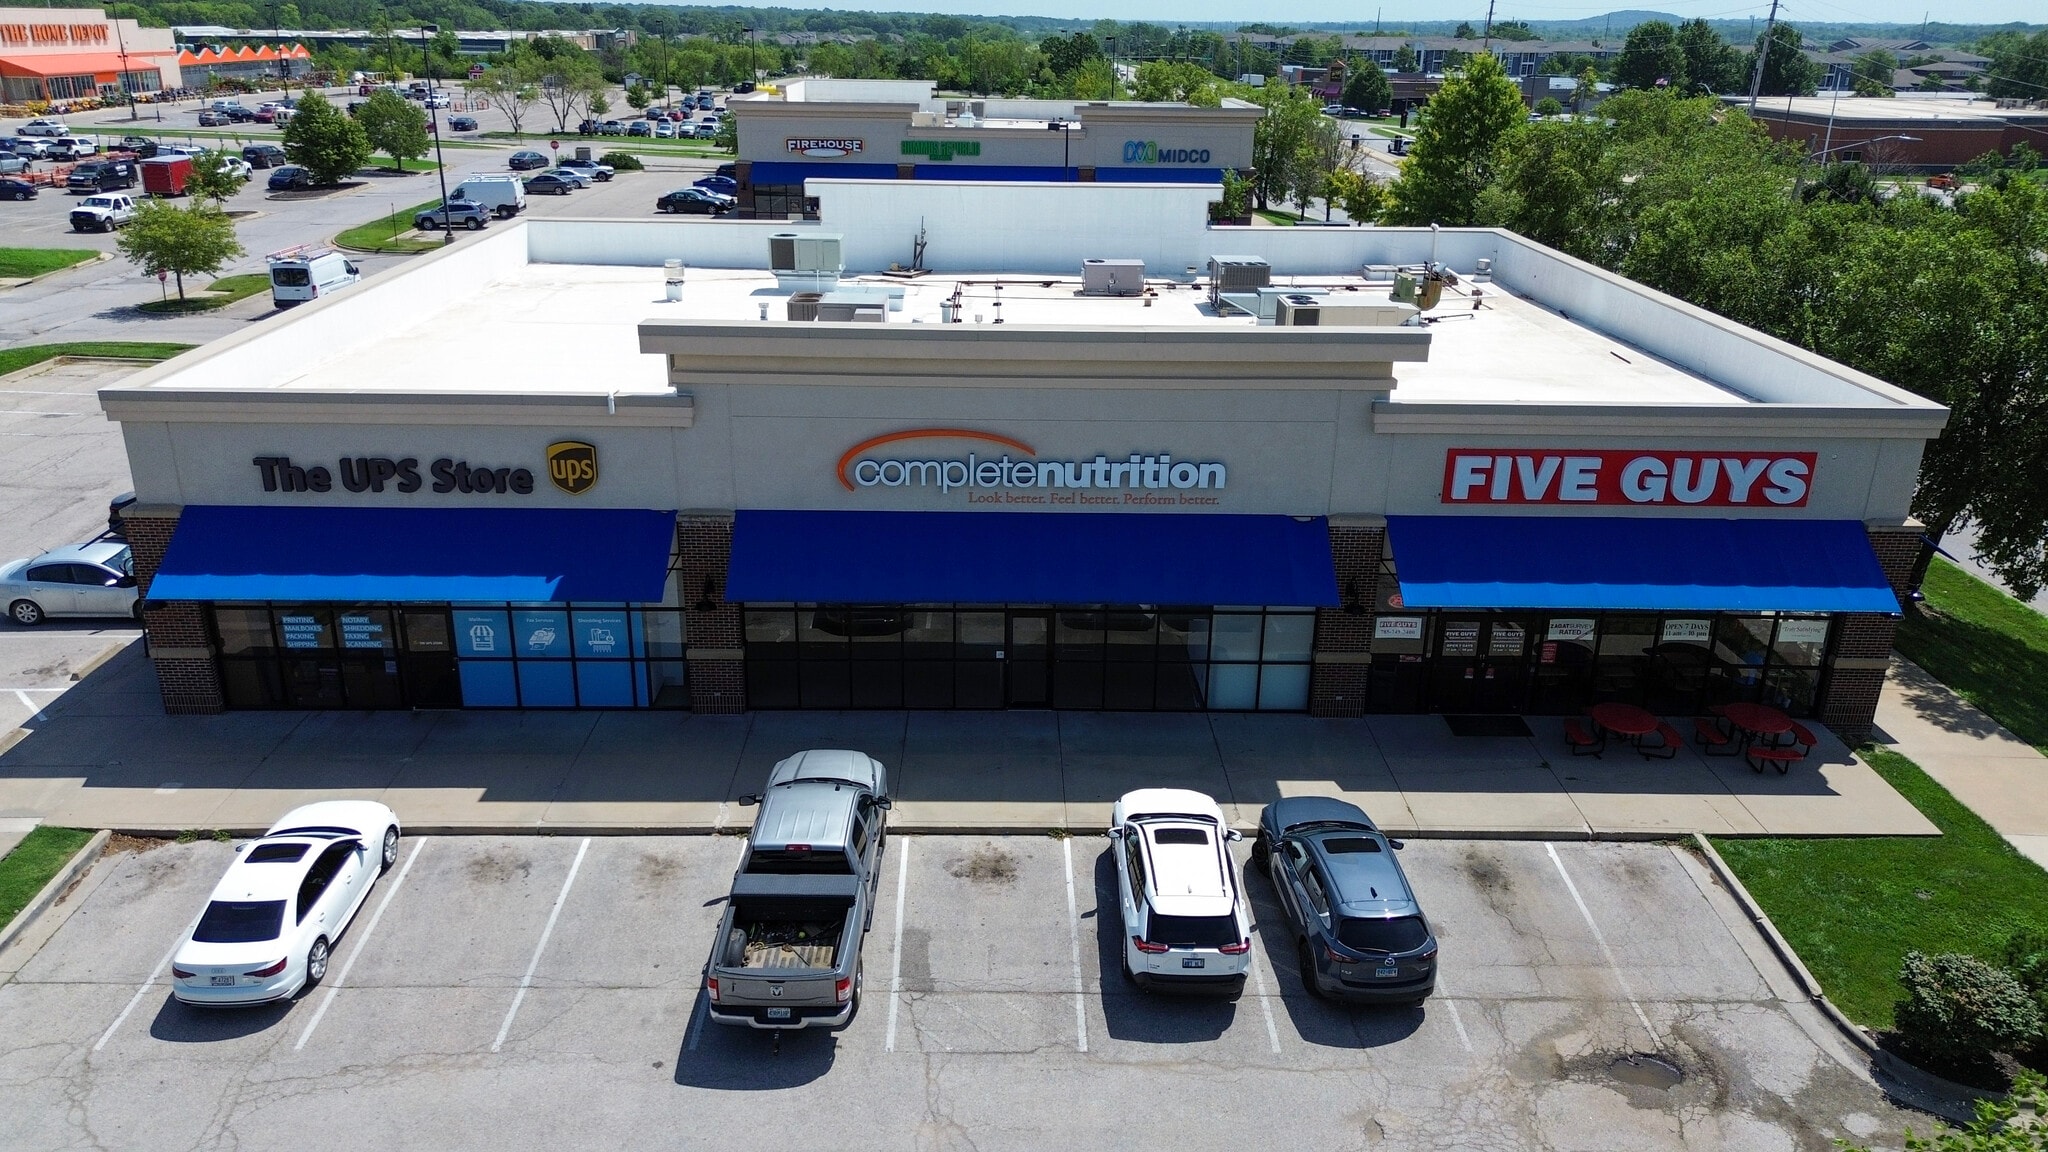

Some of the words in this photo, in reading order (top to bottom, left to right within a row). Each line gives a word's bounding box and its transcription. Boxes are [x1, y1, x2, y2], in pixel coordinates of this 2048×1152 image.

[0, 24, 28, 42] THE
[30, 24, 68, 42] HOME
[69, 24, 108, 41] DEPOT
[787, 139, 862, 153] FIREHOUSE
[1158, 149, 1210, 163] MIDCO
[252, 456, 333, 492] The
[339, 457, 422, 493] UPS
[430, 458, 534, 494] Store
[552, 458, 594, 487] ups
[1450, 455, 1603, 501] FIVE
[1620, 455, 1810, 505] GUYS
[968, 491, 1003, 504] Look
[1005, 491, 1046, 504] better.
[1050, 492, 1075, 504] Feel
[1079, 492, 1120, 505] better.
[1123, 492, 1176, 506] Perform
[1179, 493, 1220, 505] better.
[284, 624, 322, 632] MAILBOXES
[1690, 623, 1709, 631] DAYS
